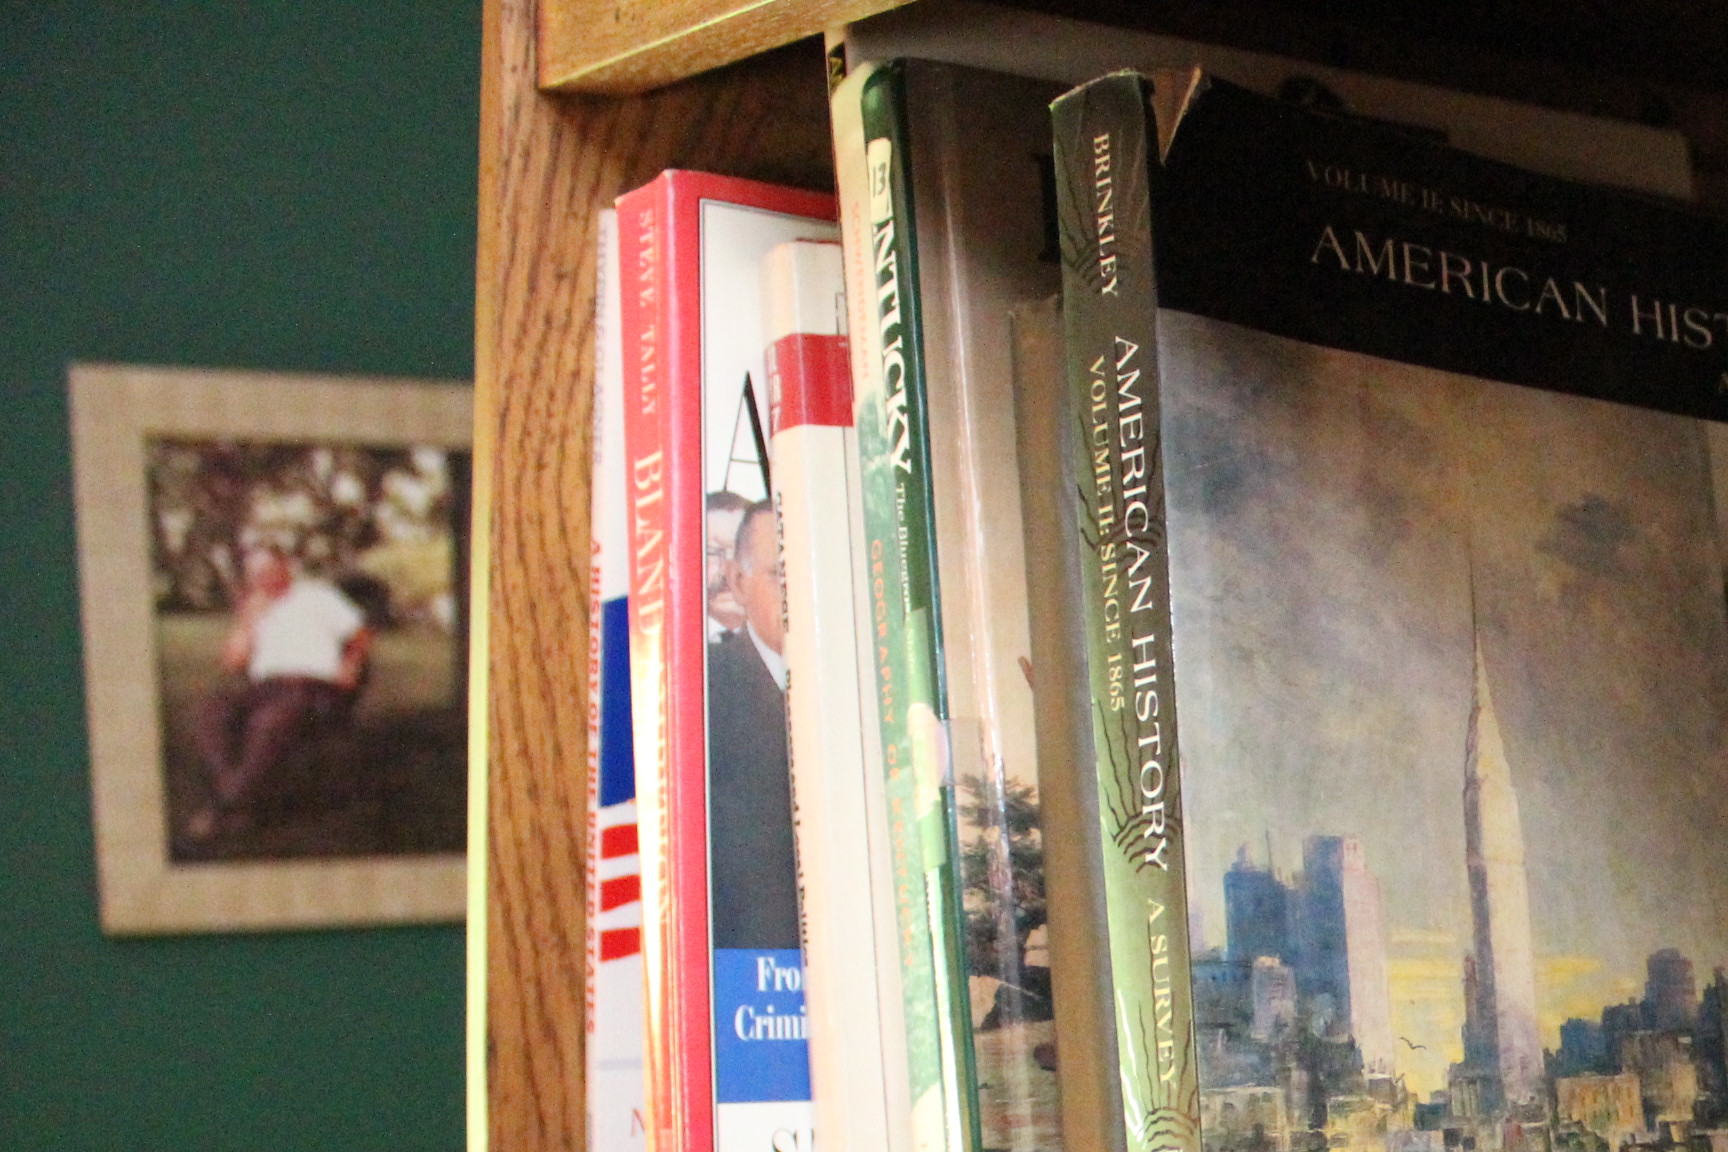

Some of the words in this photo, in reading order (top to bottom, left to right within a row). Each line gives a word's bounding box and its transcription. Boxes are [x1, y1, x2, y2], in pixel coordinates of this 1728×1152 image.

[1093, 133, 1118, 297] BRINKLEY
[1303, 159, 1413, 206] VOLUME
[1450, 196, 1520, 231] SINCE
[1527, 215, 1568, 244] 1865
[638, 209, 656, 308] STEVE
[1310, 225, 1608, 329] AMERICAN
[640, 325, 657, 416] TALLY
[872, 219, 912, 474] NTUCKY
[1089, 355, 1112, 496] VOLUME
[1115, 335, 1153, 613] AMERICAN
[634, 448, 664, 636] BLAND
[588, 565, 601, 695] HISTORY
[1100, 543, 1122, 645] SINCE
[587, 701, 598, 734] OF
[1107, 652, 1126, 712] 1865
[586, 750, 598, 803] THE
[887, 744, 900, 780] OF
[1131, 634, 1168, 871] HISTORY
[585, 810, 598, 918] UNITED
[1146, 897, 1164, 924] A
[585, 927, 597, 1036] STATES
[734, 1004, 811, 1041] Crimi
[755, 956, 803, 992] Fro
[1150, 934, 1177, 1091] SURVEY
